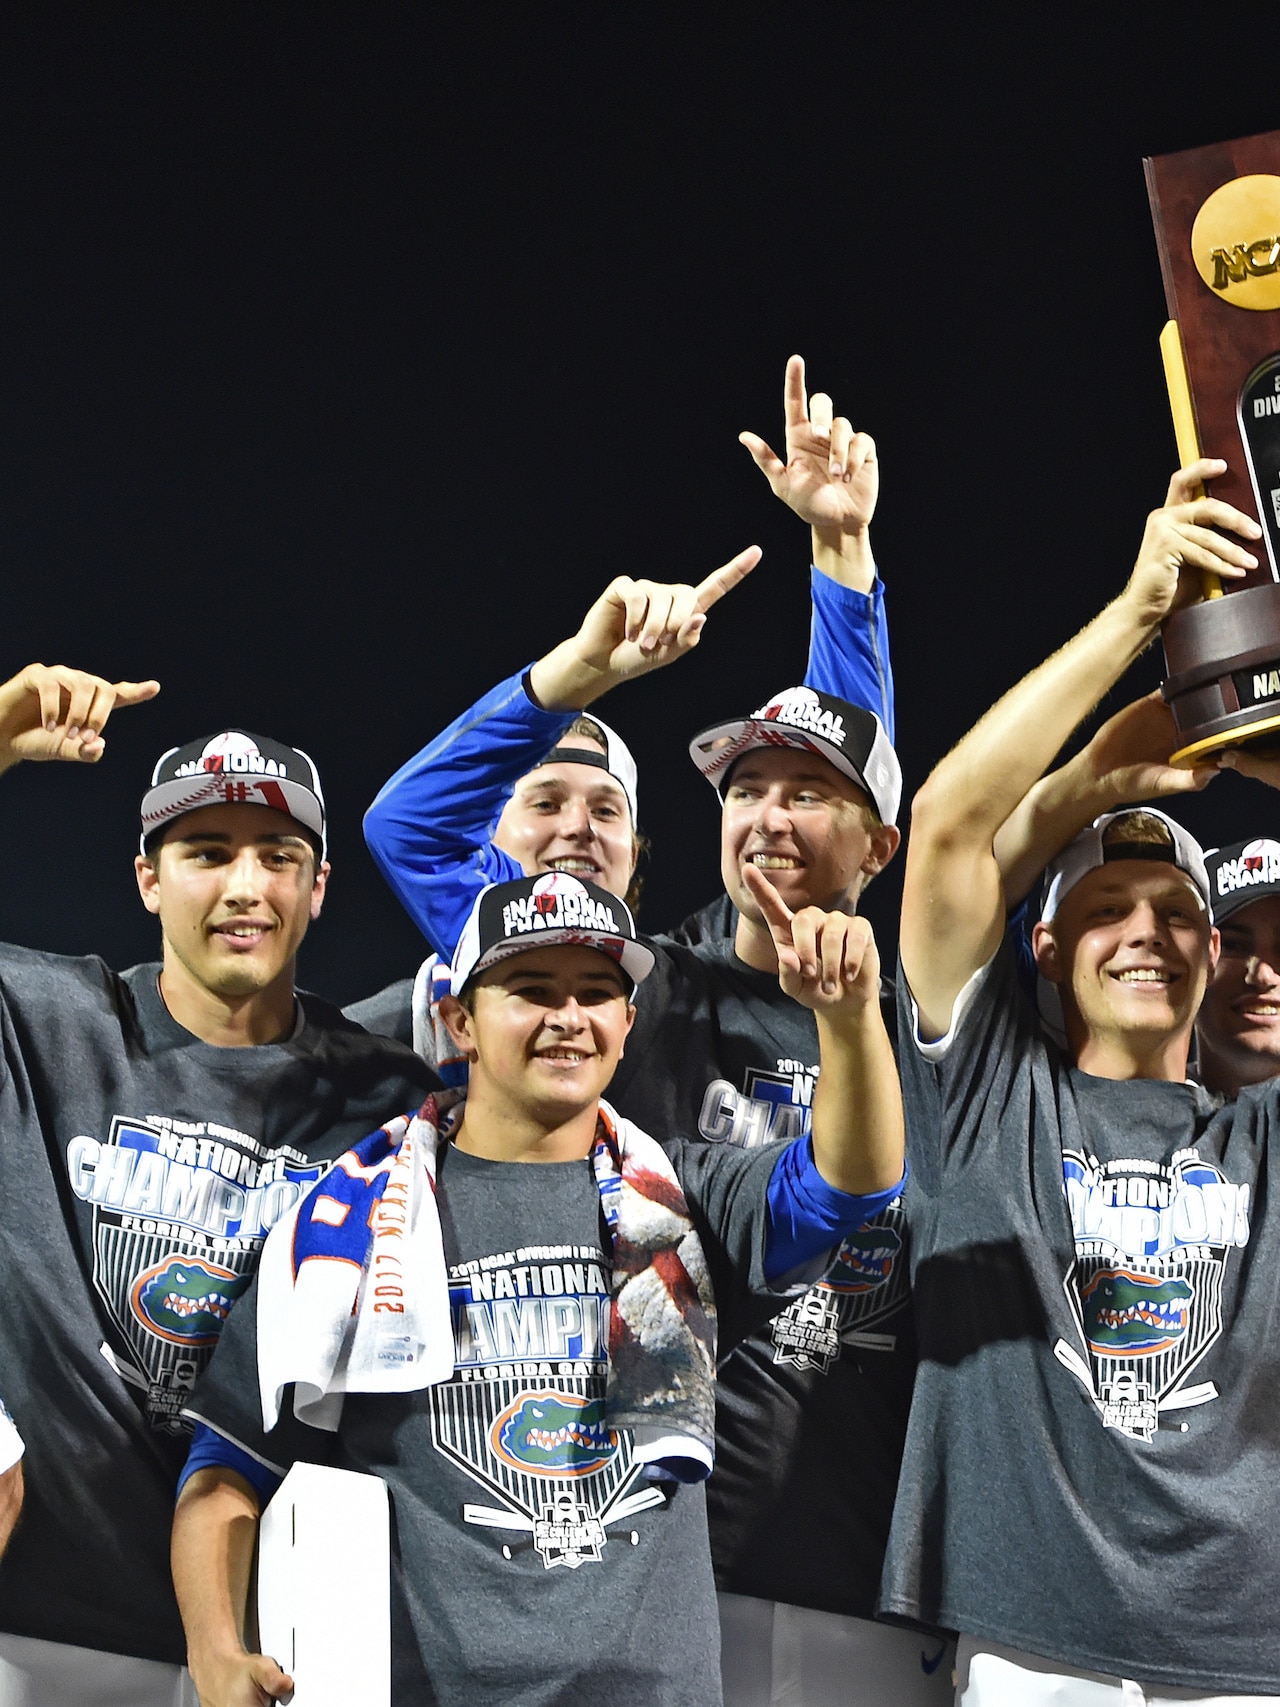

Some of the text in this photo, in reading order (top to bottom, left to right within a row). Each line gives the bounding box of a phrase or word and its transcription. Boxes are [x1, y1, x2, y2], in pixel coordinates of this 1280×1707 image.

[217, 780, 292, 817] #1
[776, 1059, 804, 1073] 2017
[698, 1079, 811, 1149] CHA
[157, 1128, 287, 1188] NATIONAL
[377, 1182, 408, 1240] NCAA
[121, 1216, 208, 1248] FLORIDA
[450, 1261, 480, 1278] 2017
[479, 1251, 517, 1271] NCAA
[516, 1244, 572, 1263] DIVISION
[374, 1254, 405, 1314] 2017
[461, 1362, 553, 1382] FLORIDA
